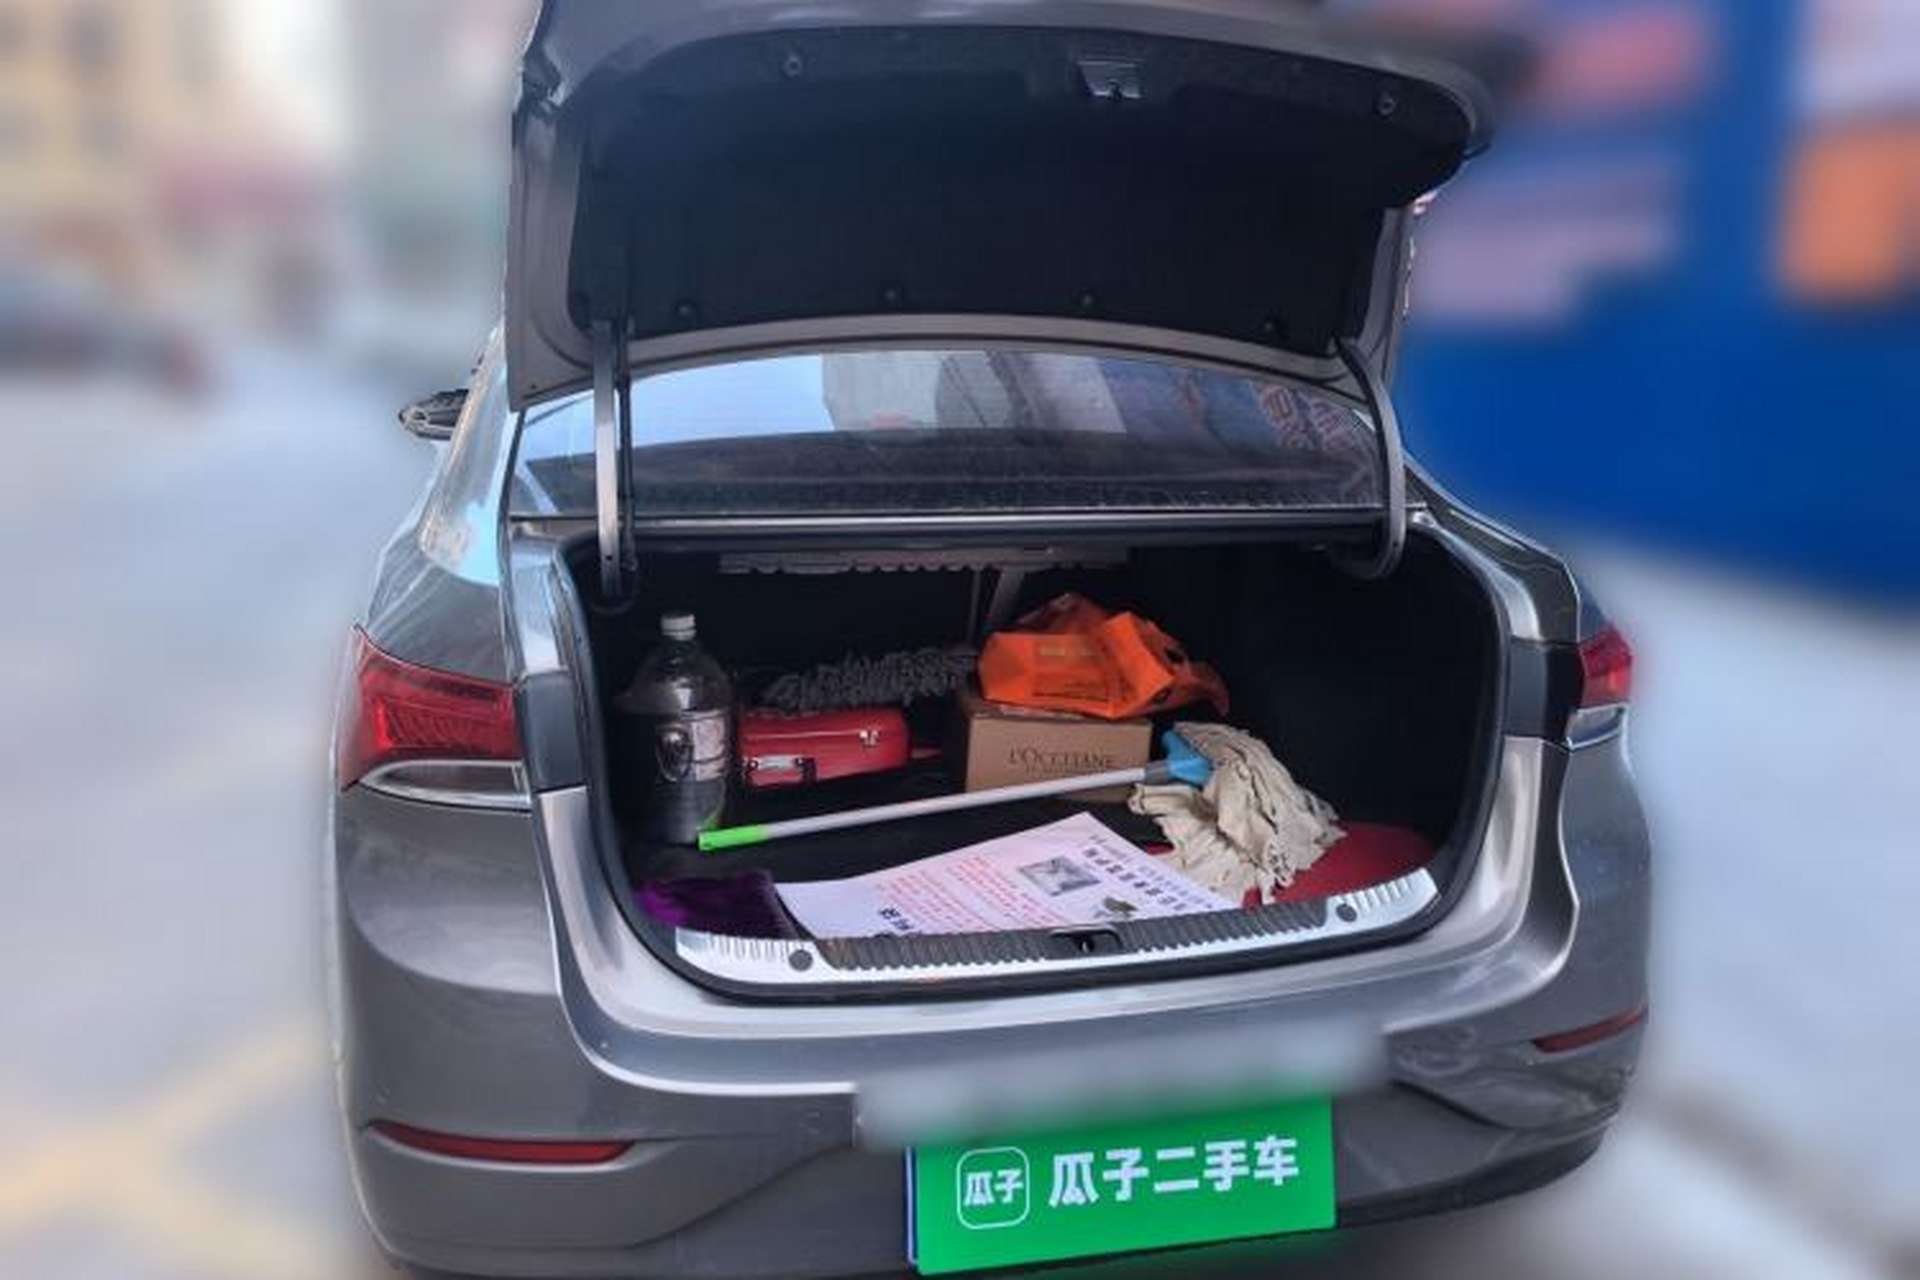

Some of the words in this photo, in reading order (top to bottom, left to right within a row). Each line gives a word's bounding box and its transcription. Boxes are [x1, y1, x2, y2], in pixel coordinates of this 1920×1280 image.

[964, 1168, 1024, 1207] 瓜子
[1049, 1134, 1299, 1207] 瓜子二手车
